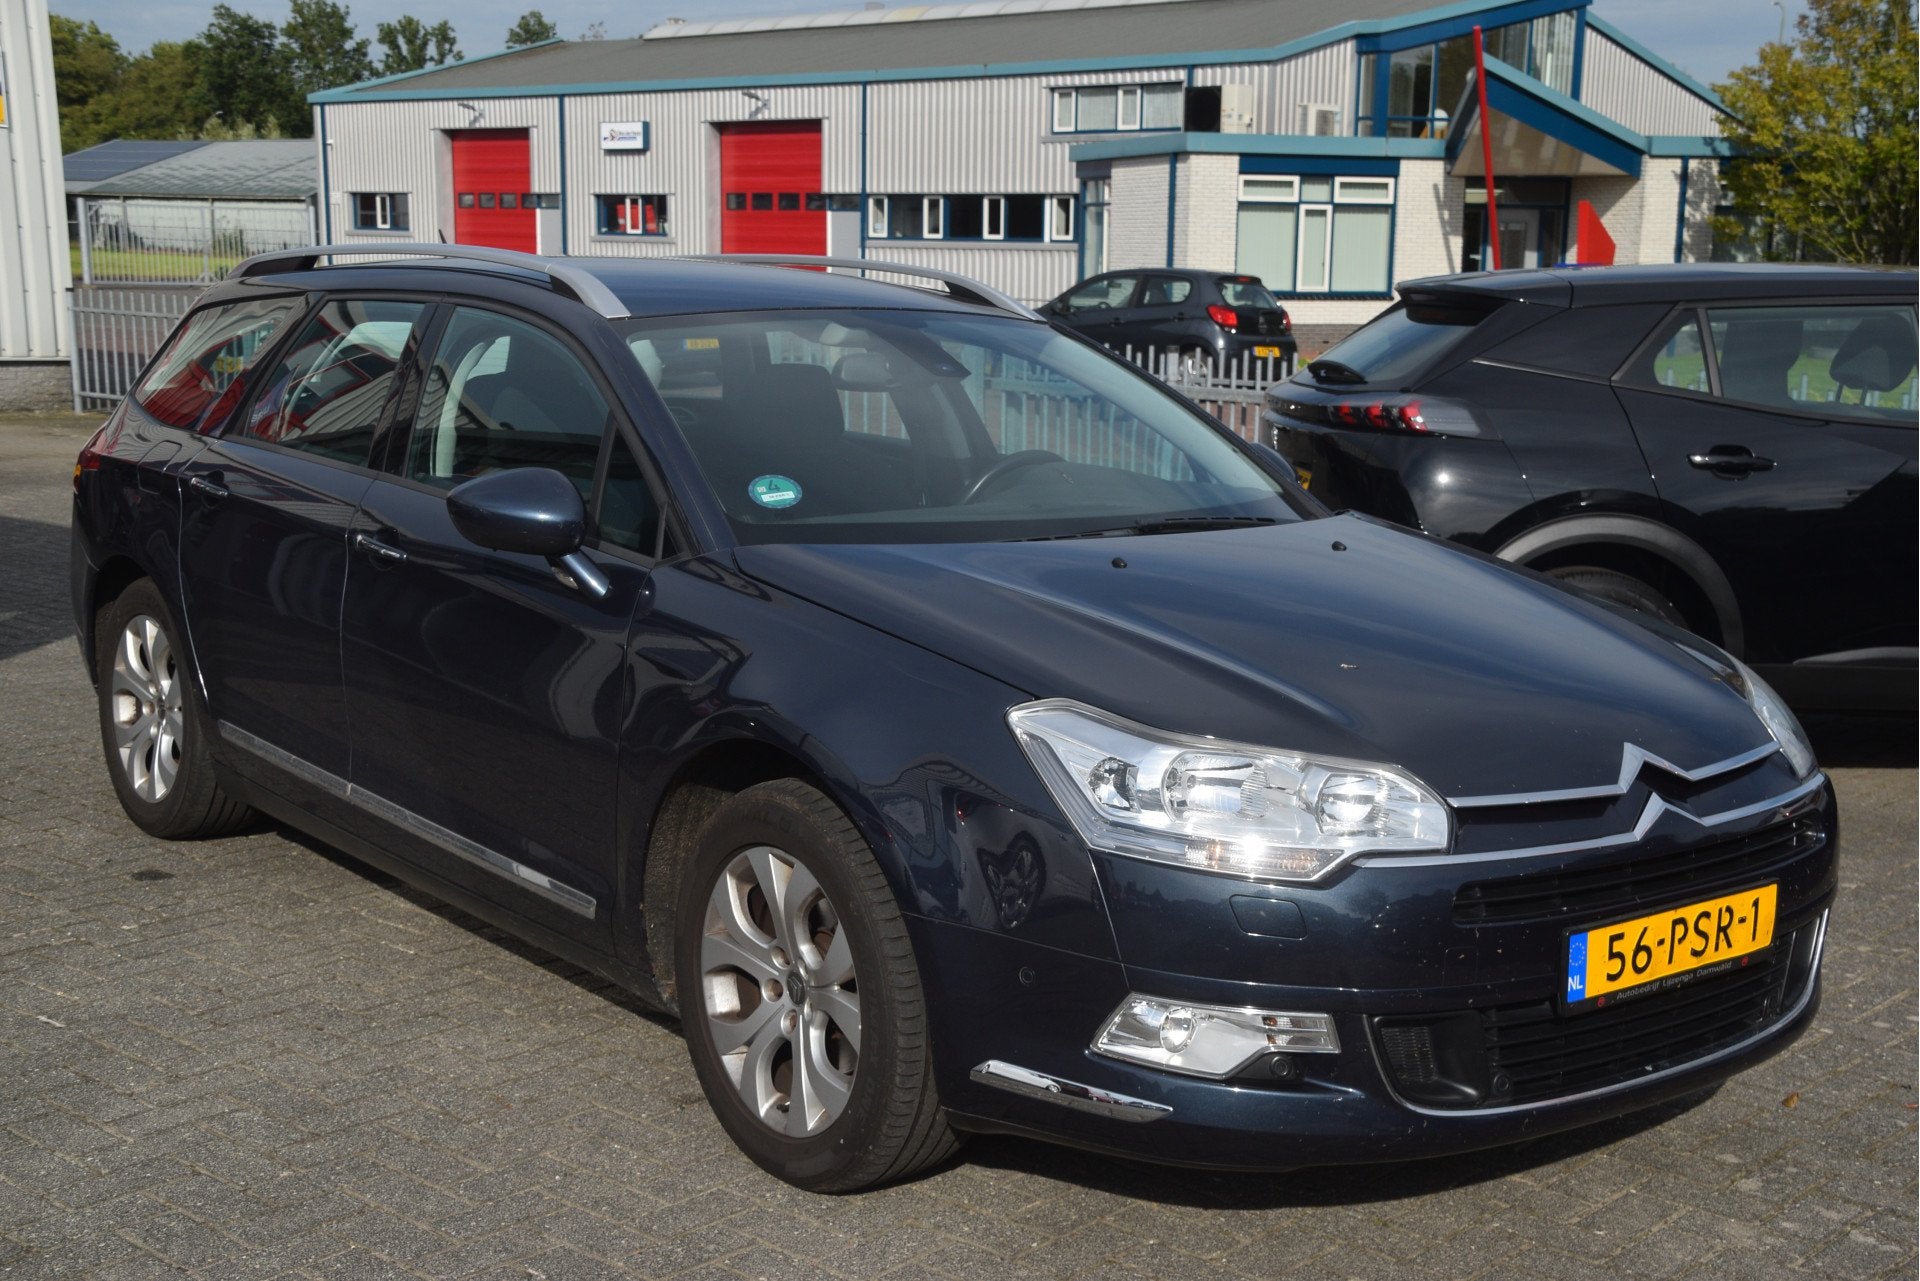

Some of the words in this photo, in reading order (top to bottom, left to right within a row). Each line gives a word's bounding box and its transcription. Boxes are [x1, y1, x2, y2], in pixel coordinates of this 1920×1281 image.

[1605, 896, 1760, 983] 56-PSR-1
[1567, 974, 1584, 992] NL
[1616, 979, 1662, 1000] Autobedrijf
